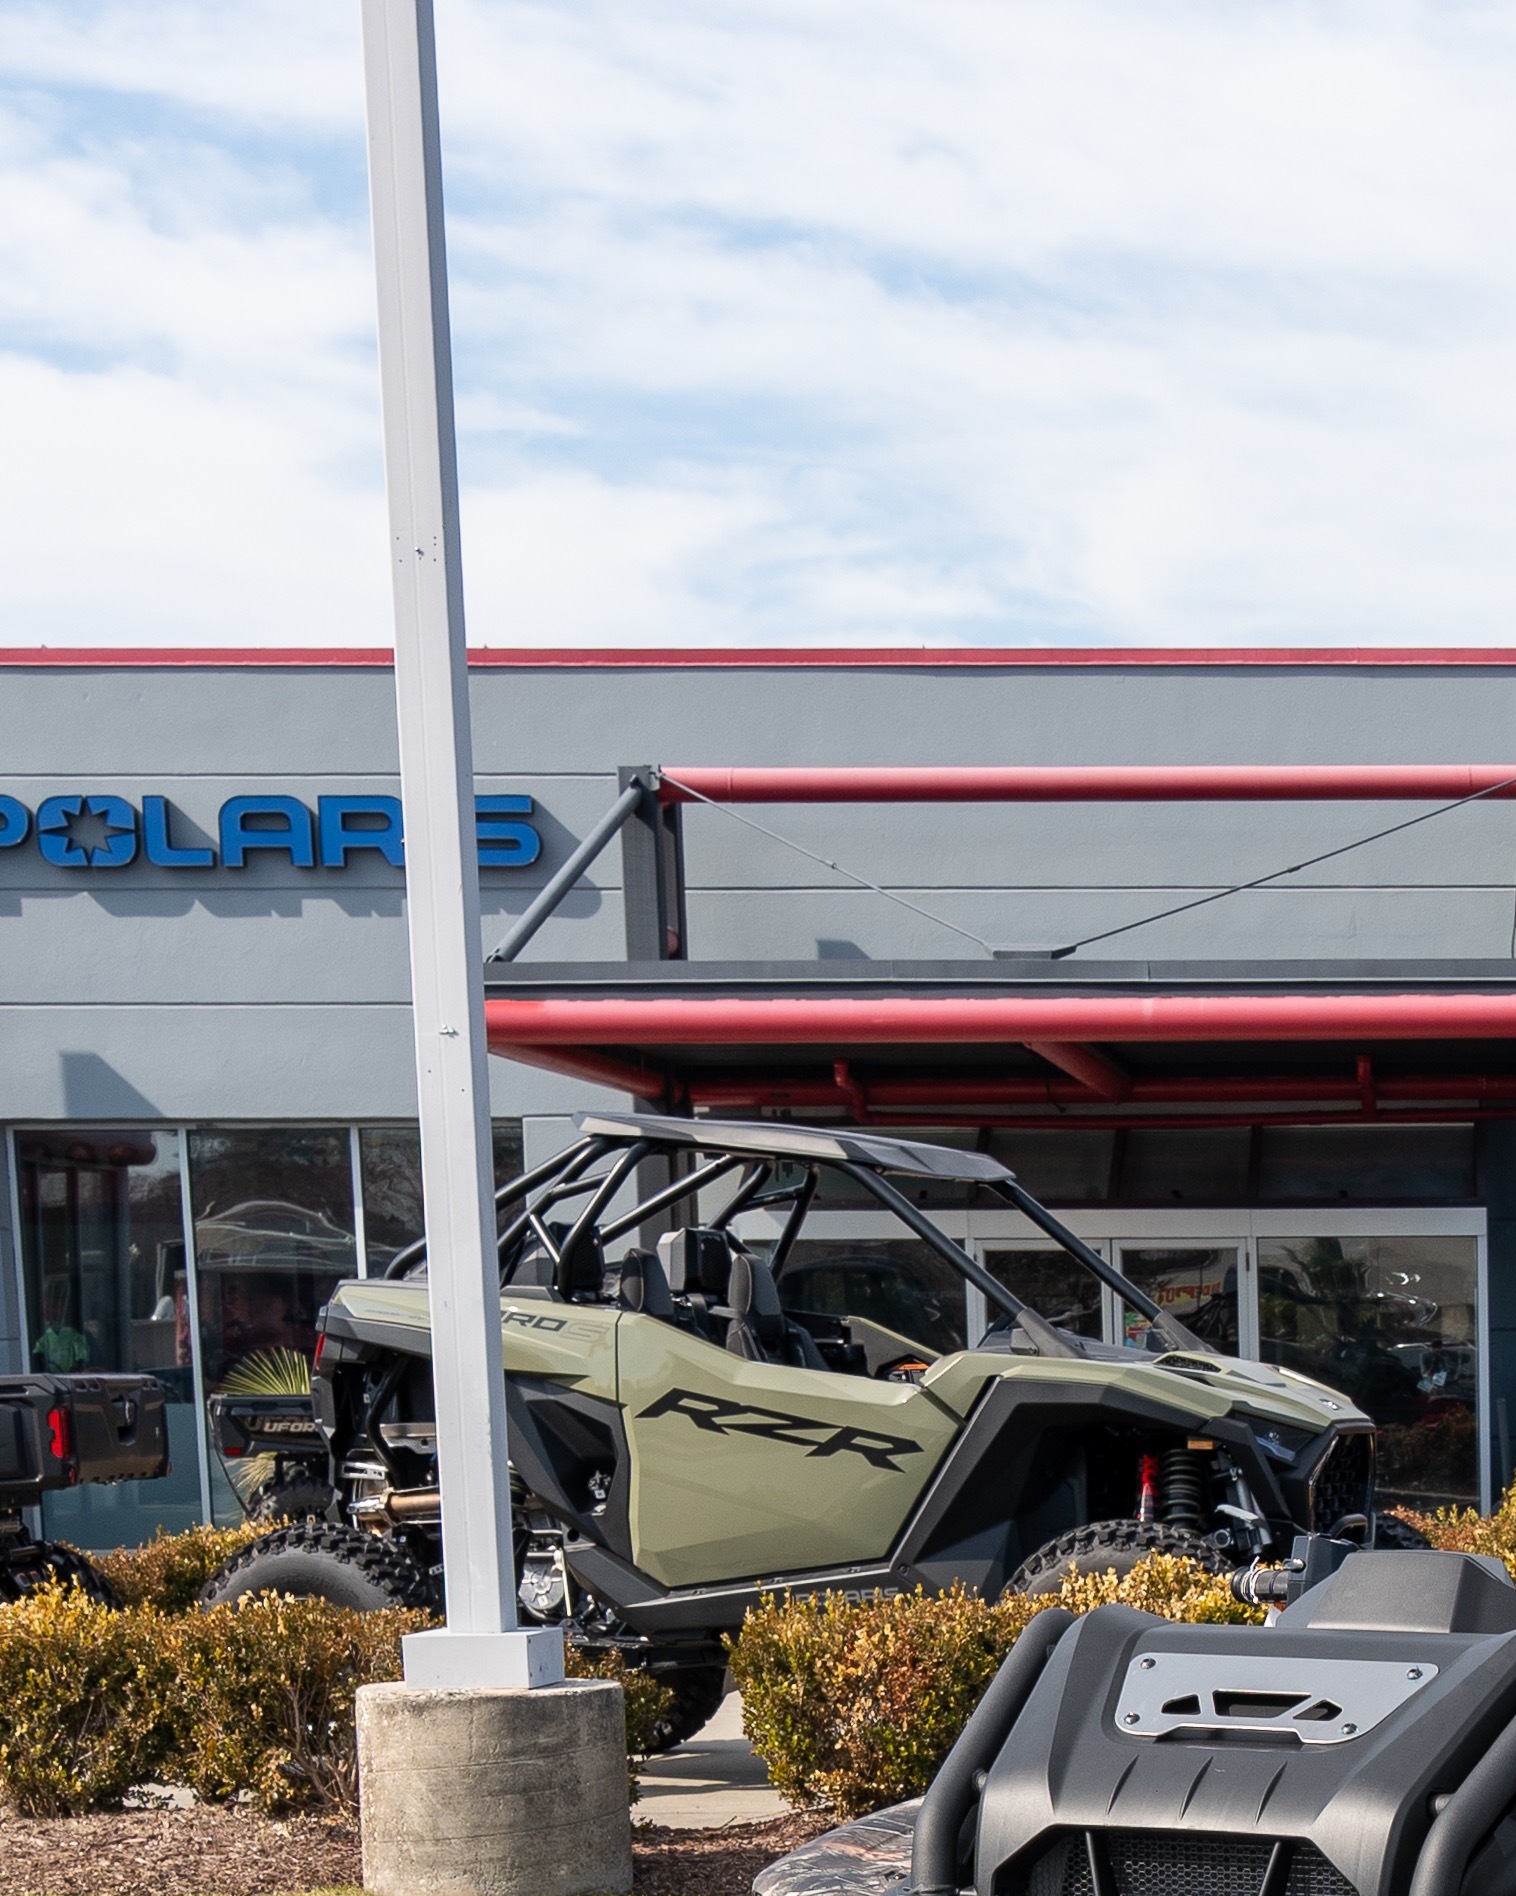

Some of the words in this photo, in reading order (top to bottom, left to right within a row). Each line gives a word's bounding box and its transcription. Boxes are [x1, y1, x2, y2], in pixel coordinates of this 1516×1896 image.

[0, 795, 541, 867] OLARS
[500, 1310, 567, 1332] RO
[263, 1422, 319, 1433] UFOR
[634, 1387, 925, 1473] RZR
